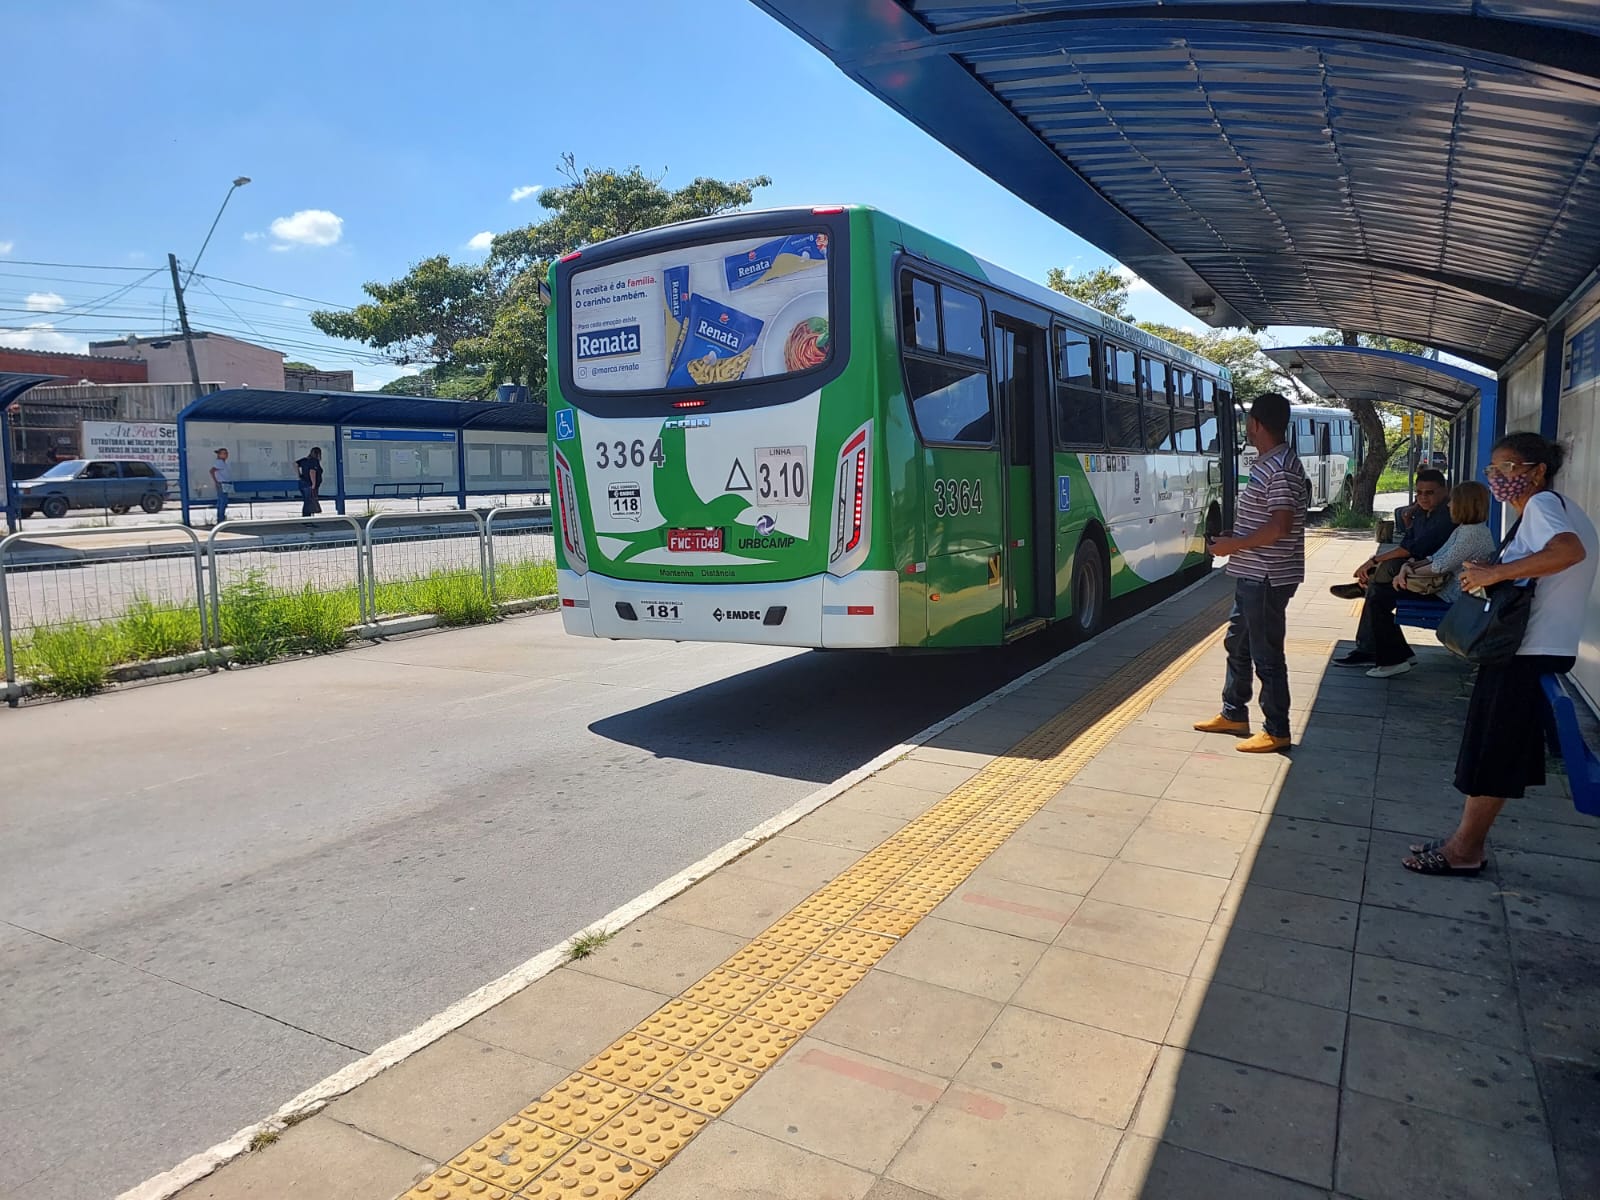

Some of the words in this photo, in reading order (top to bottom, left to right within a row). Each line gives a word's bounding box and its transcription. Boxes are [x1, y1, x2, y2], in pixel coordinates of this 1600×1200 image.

[738, 260, 770, 277] Renata
[575, 288, 581, 296] A
[582, 284, 608, 296] receita
[616, 281, 626, 290] da
[575, 300, 581, 309] O
[583, 297, 611, 308] carinho
[672, 281, 680, 316] Renata
[698, 320, 739, 348] Renata
[578, 331, 639, 357] Renata
[595, 438, 666, 469] 3364
[769, 448, 791, 456] LINHA
[759, 461, 805, 499] 3.10
[613, 498, 639, 512] 118
[934, 478, 983, 518] 3364
[670, 537, 720, 550] FWC-1048
[738, 537, 796, 550] URBCAMP
[659, 568, 694, 577] Mantenha
[646, 605, 679, 618] 181
[726, 610, 761, 620] EMDEC
